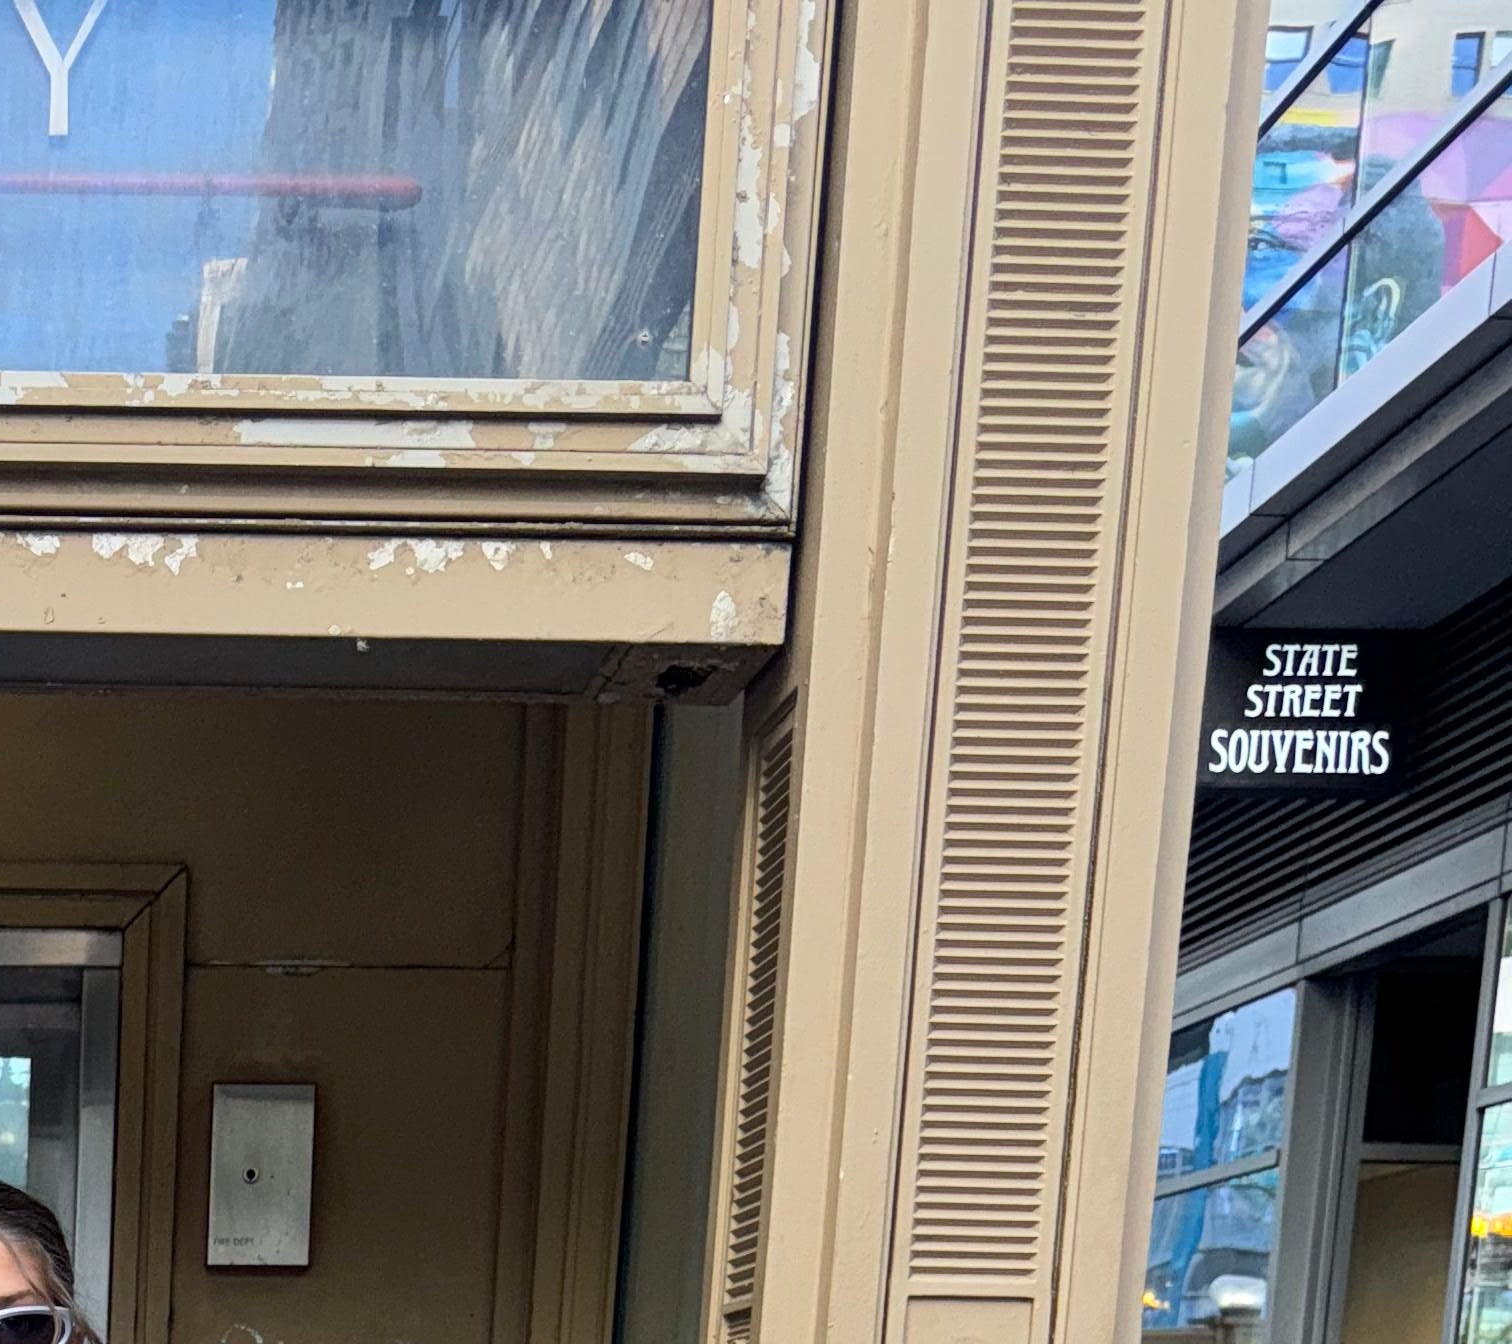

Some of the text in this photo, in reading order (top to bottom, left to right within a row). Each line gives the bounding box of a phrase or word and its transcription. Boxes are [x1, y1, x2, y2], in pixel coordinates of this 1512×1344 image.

[1262, 643, 1359, 677] STATE
[1244, 683, 1363, 718] STREET
[1208, 728, 1390, 775] SOUVENIRS
